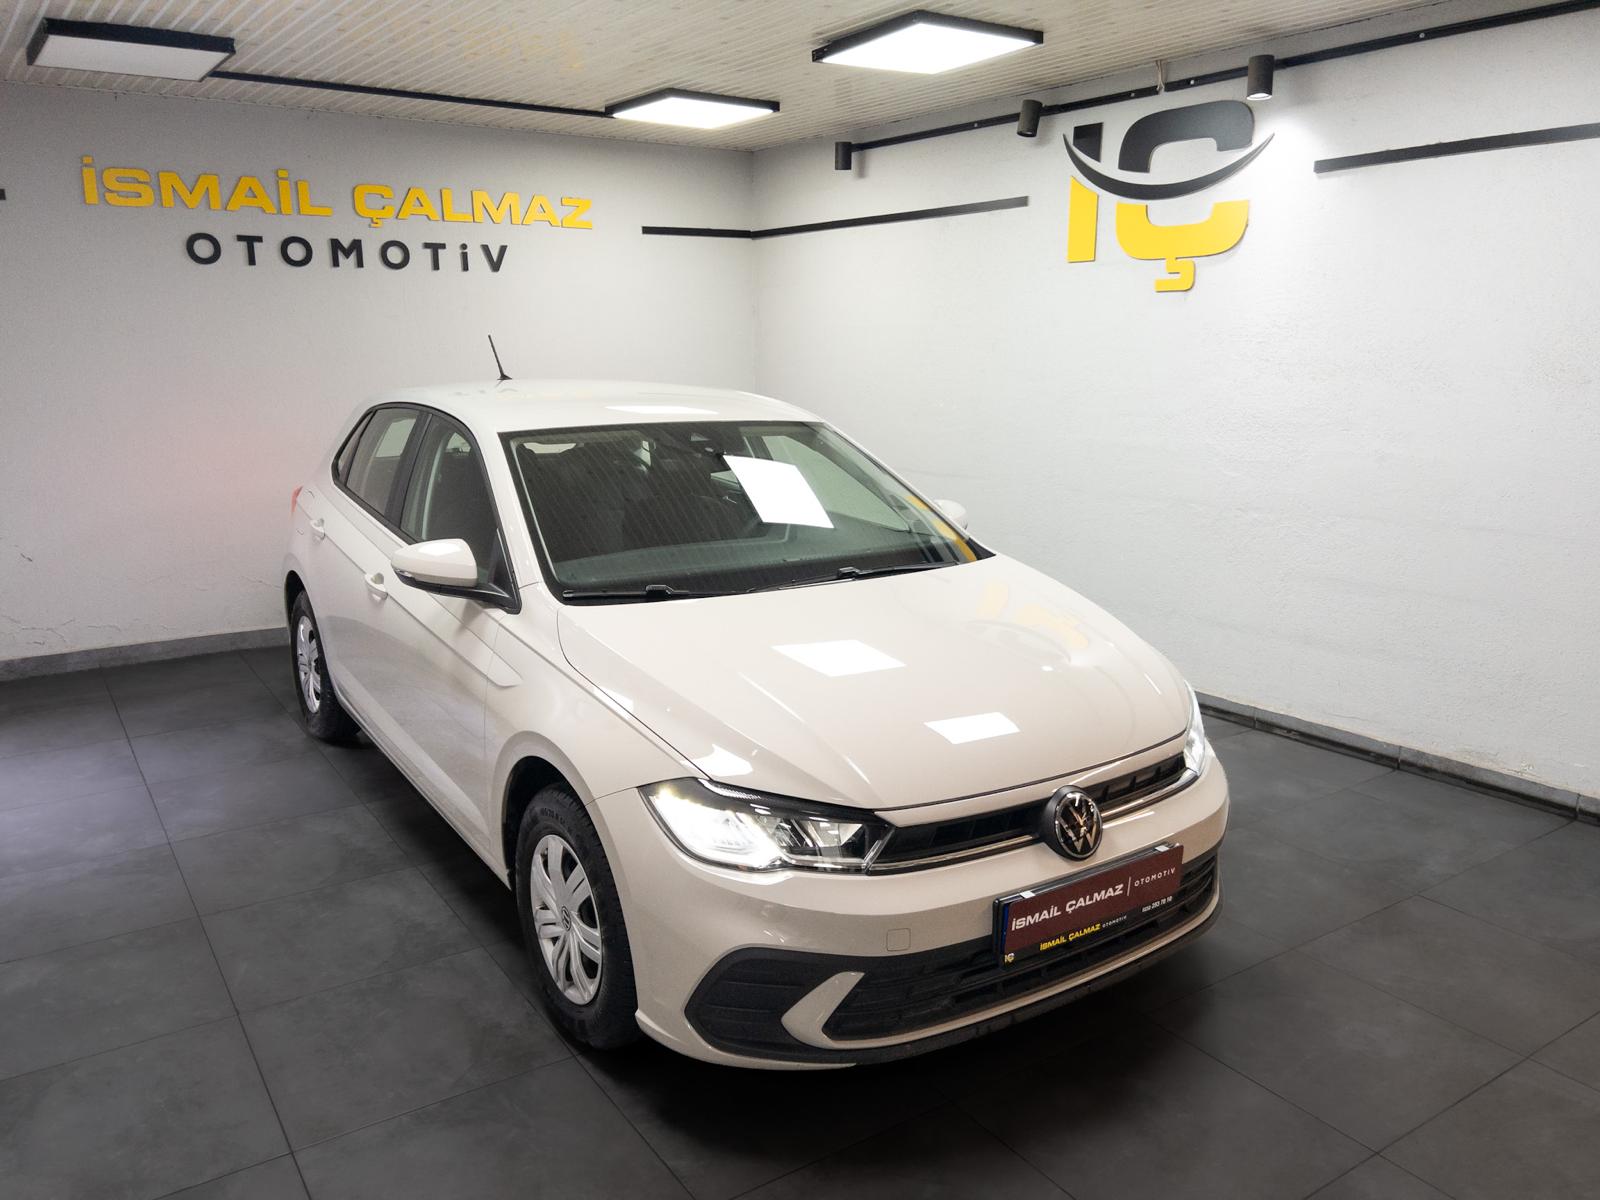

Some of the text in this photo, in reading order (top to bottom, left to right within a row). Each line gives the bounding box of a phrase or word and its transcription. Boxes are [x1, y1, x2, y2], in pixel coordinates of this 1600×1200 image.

[81, 156, 593, 229] İSMAİL ÇALMAZ
[1012, 906, 1062, 931] İSMAİL
[1065, 884, 1124, 913] ÇALMAZ
[1068, 923, 1101, 941] ÇALMAZ
